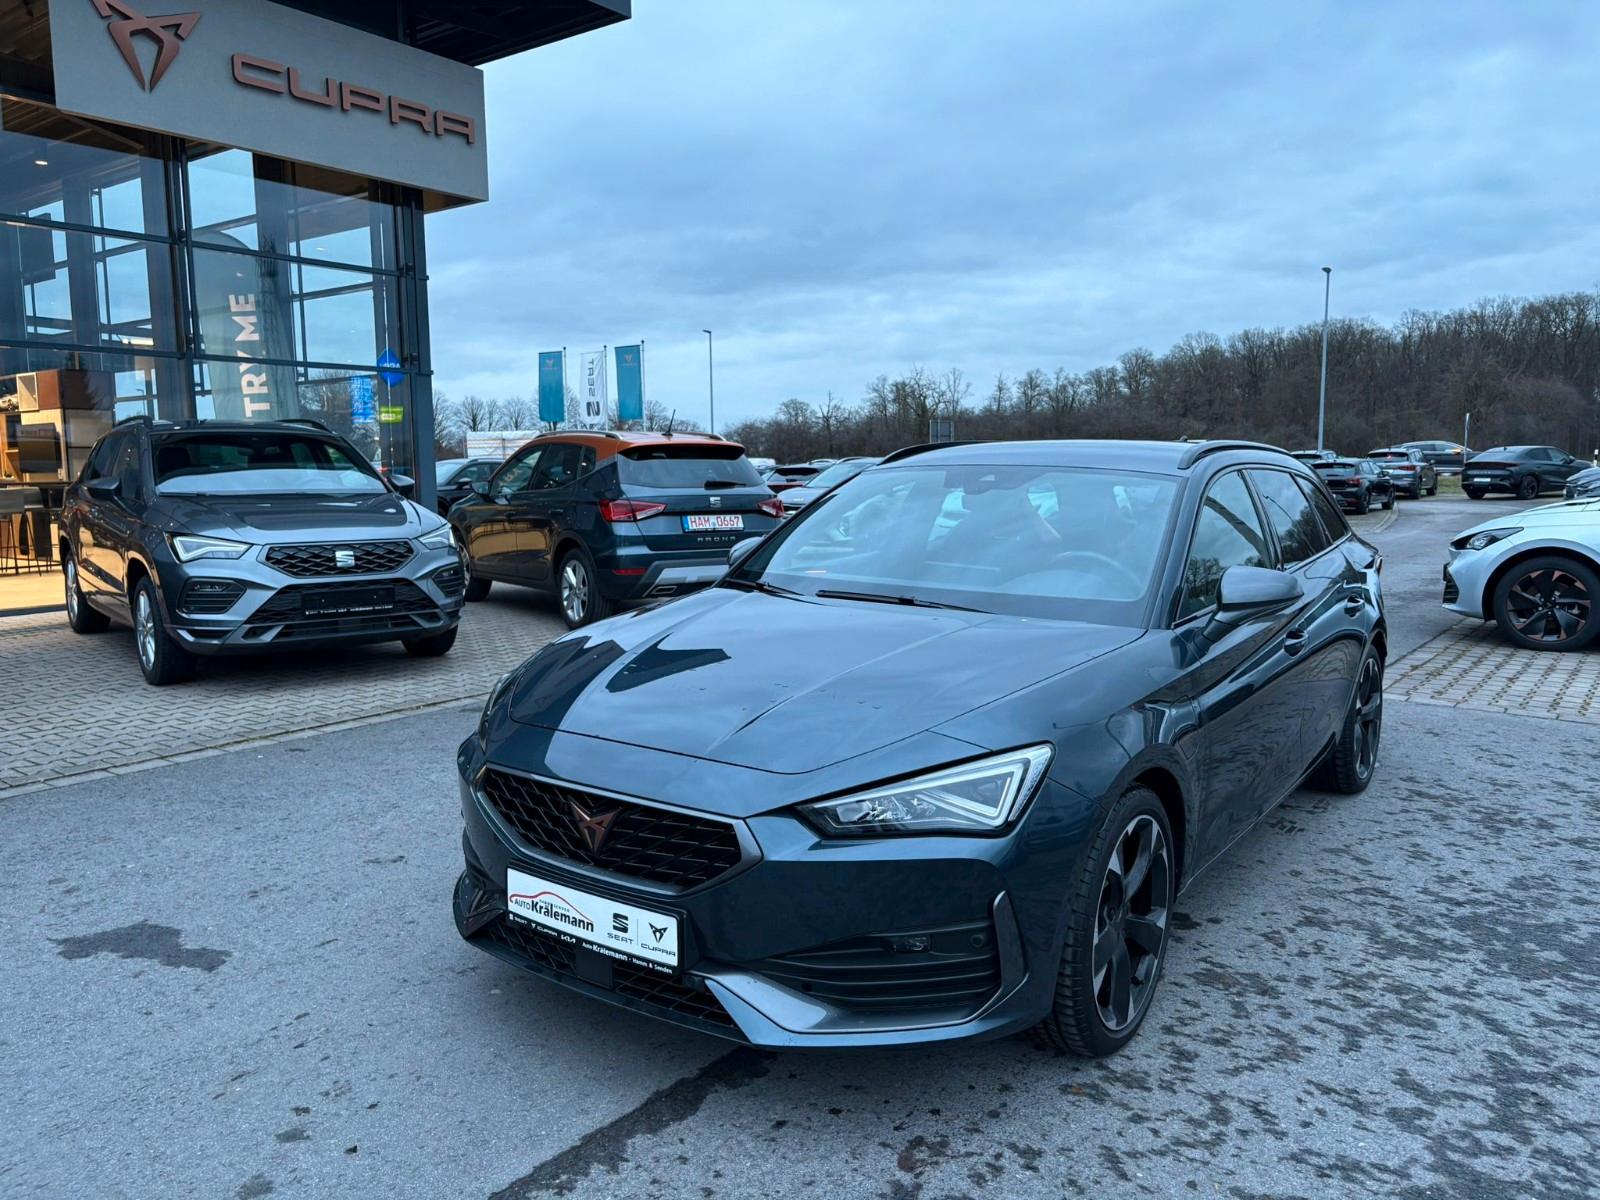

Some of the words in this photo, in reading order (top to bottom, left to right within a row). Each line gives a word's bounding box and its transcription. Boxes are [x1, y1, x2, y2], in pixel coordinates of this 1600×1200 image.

[231, 52, 476, 145] CUPRA
[228, 293, 260, 342] ME
[236, 350, 271, 418] TRY
[690, 516, 711, 528] HAM
[716, 515, 740, 527] 0667
[514, 898, 531, 911] AUTO
[531, 899, 594, 933] Krälemann
[607, 932, 634, 945] SEAT
[640, 943, 676, 957] CUPRA
